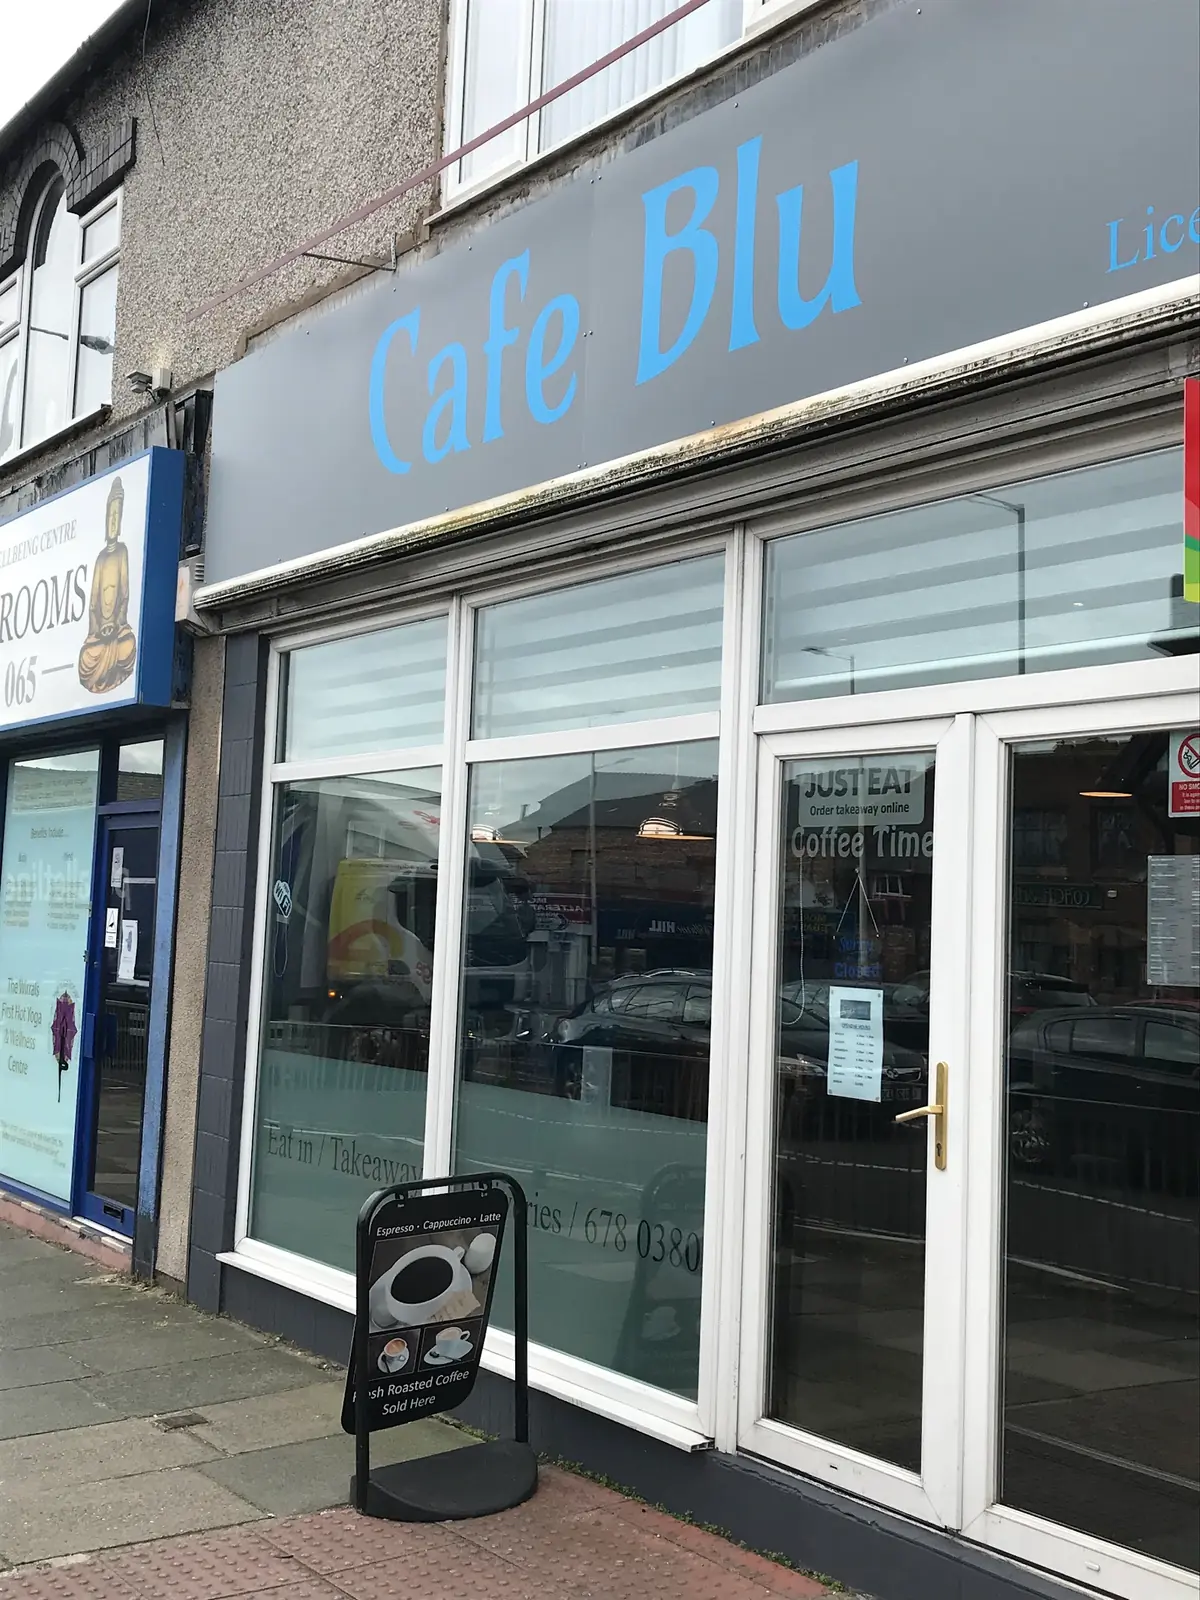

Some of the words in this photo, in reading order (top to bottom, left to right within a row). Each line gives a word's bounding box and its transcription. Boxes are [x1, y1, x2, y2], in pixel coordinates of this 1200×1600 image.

[369, 248, 580, 475] Cafe
[636, 134, 863, 386] Blu
[40, 519, 77, 552] CENTRE
[0, 564, 88, 643] ROOMS
[4, 655, 38, 708] 065
[804, 768, 864, 799] JUST
[868, 765, 917, 796] EAT
[810, 805, 834, 816] Order
[836, 804, 878, 816] takeaway
[880, 802, 910, 814] online
[791, 826, 865, 858] Coffee
[872, 825, 933, 858] Time
[1, 1002, 14, 1019] First
[15, 1004, 26, 1021] Hot
[27, 1007, 42, 1028] Yoga
[8, 1055, 28, 1075] Centre
[268, 1121, 294, 1160] Eat
[298, 1130, 313, 1164] in
[376, 1223, 414, 1237] Espresso
[423, 1215, 472, 1230] Cappuccino
[480, 1213, 501, 1223] Latte
[584, 1207, 627, 1252] 678
[637, 1219, 700, 1273] 0380
[352, 1385, 385, 1403] Fsh
[387, 1376, 434, 1396] Roasted
[435, 1369, 470, 1386] Coffee
[382, 1400, 408, 1416] Sold
[410, 1395, 436, 1409] Here
